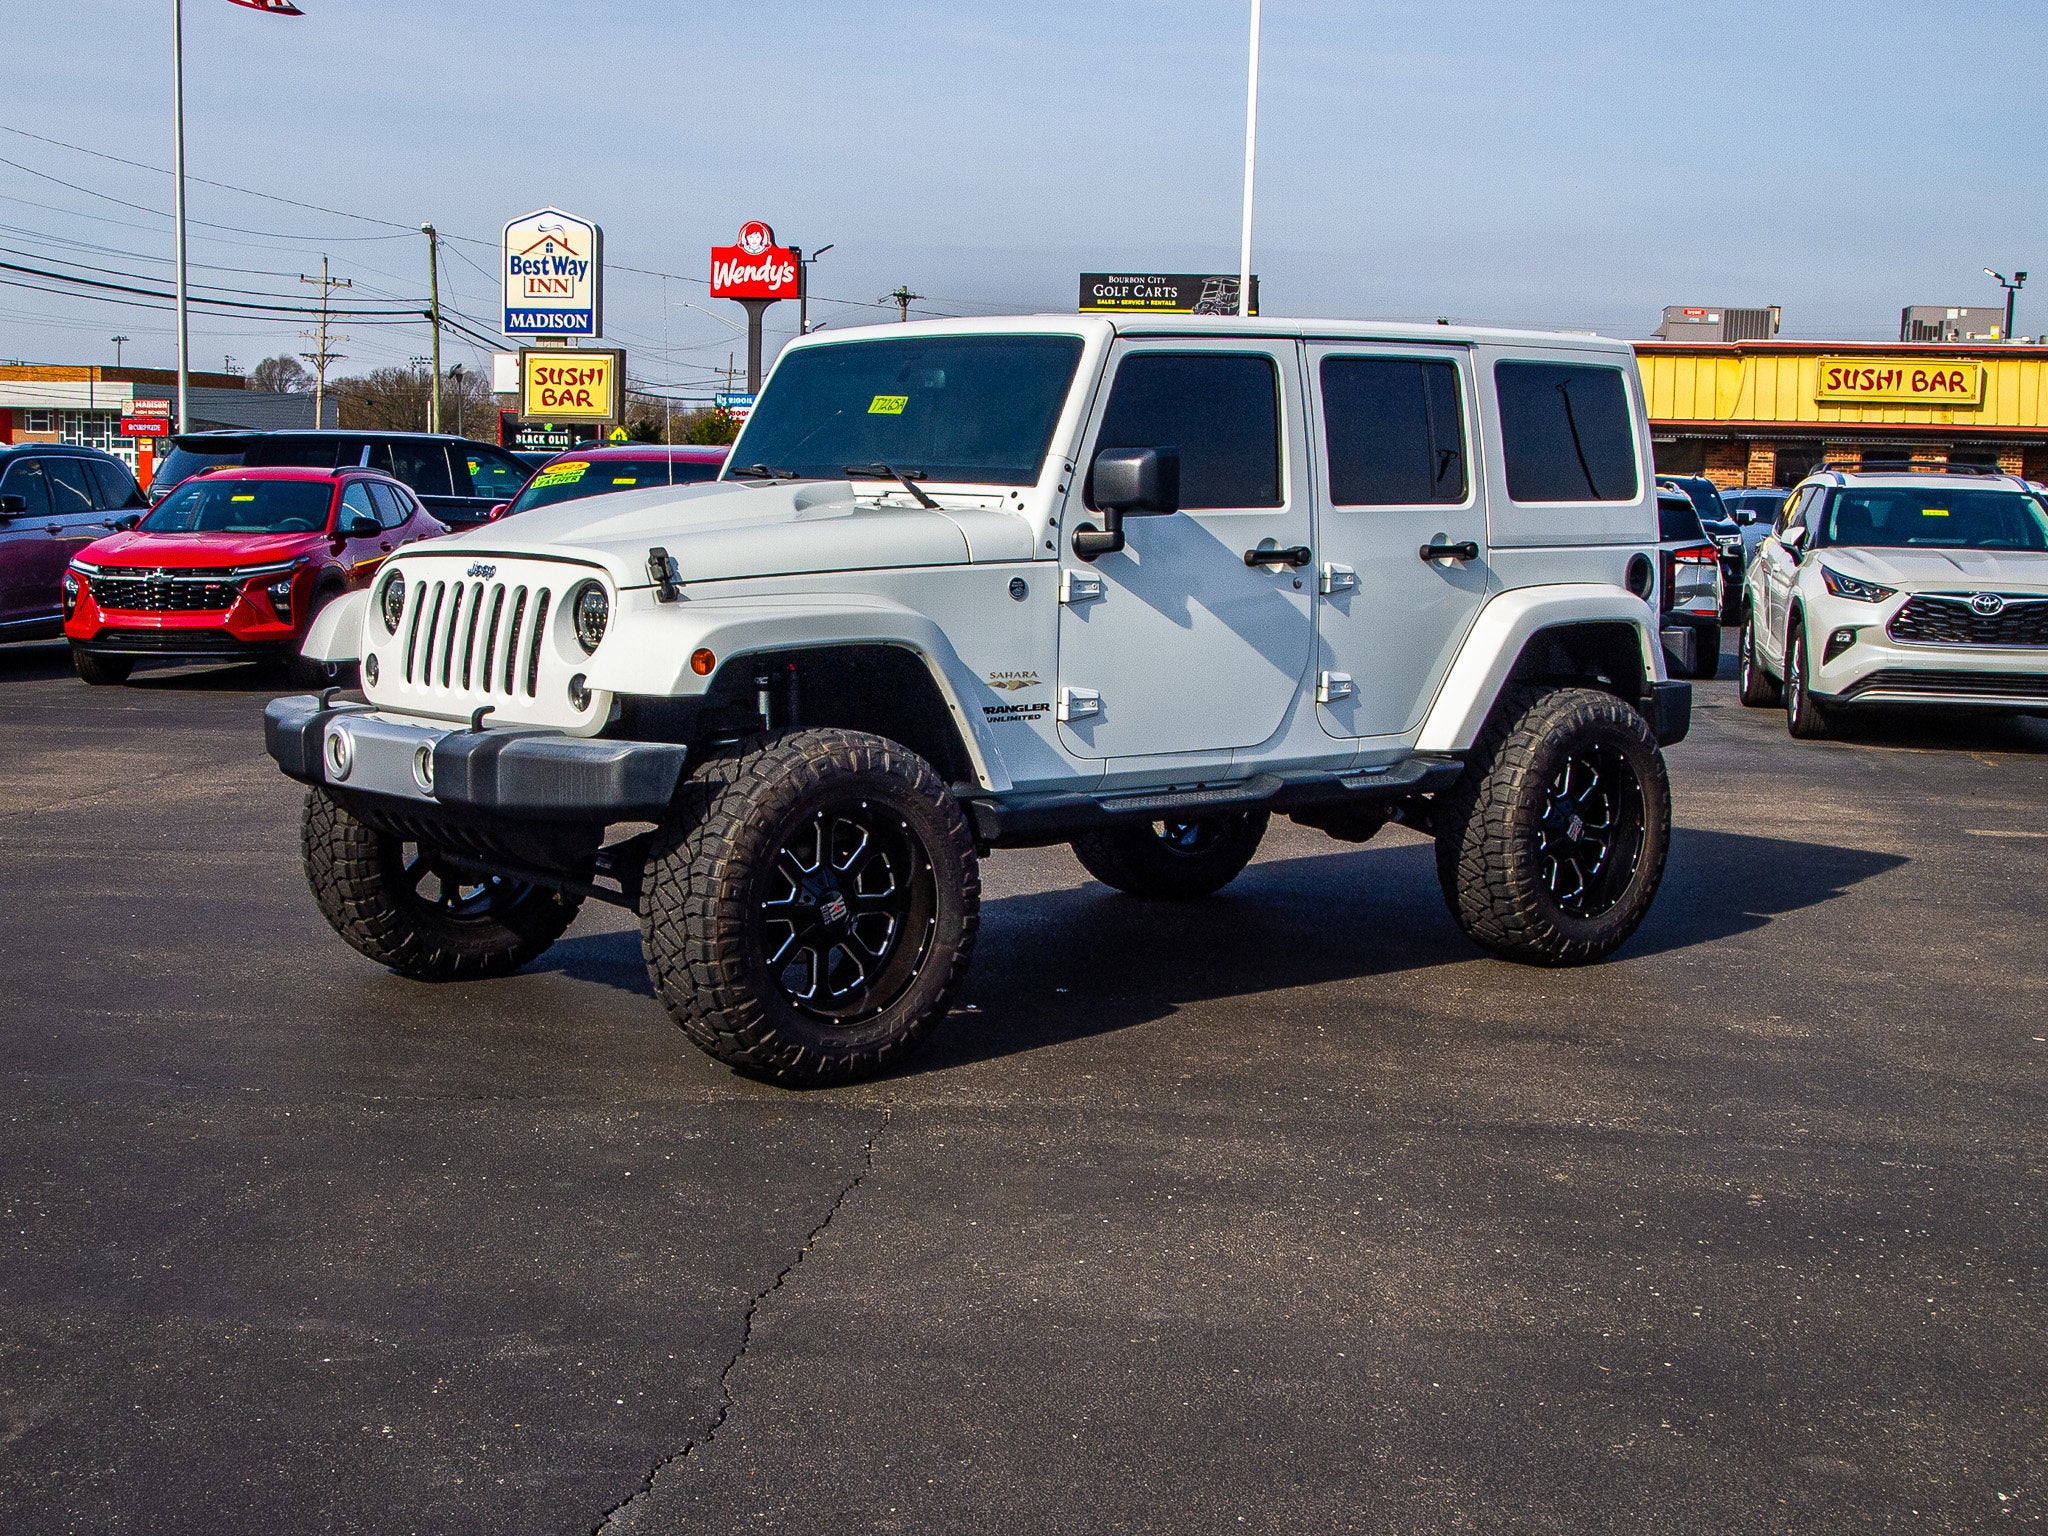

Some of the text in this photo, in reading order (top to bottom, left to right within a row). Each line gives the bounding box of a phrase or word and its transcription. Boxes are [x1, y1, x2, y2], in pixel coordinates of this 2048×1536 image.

[510, 255, 589, 283] Best Way
[713, 254, 795, 291] Wendy's
[528, 278, 570, 294] INN
[509, 313, 589, 329] MADISON
[534, 366, 604, 386] SUSHI
[1826, 368, 1968, 392] SUSHI BAR
[541, 388, 594, 407] BAR
[515, 434, 581, 445] BLACK OLIVS
[467, 560, 496, 581] Jeep
[989, 671, 1039, 679] SAHARA
[986, 713, 1041, 723] UNLIMITED
